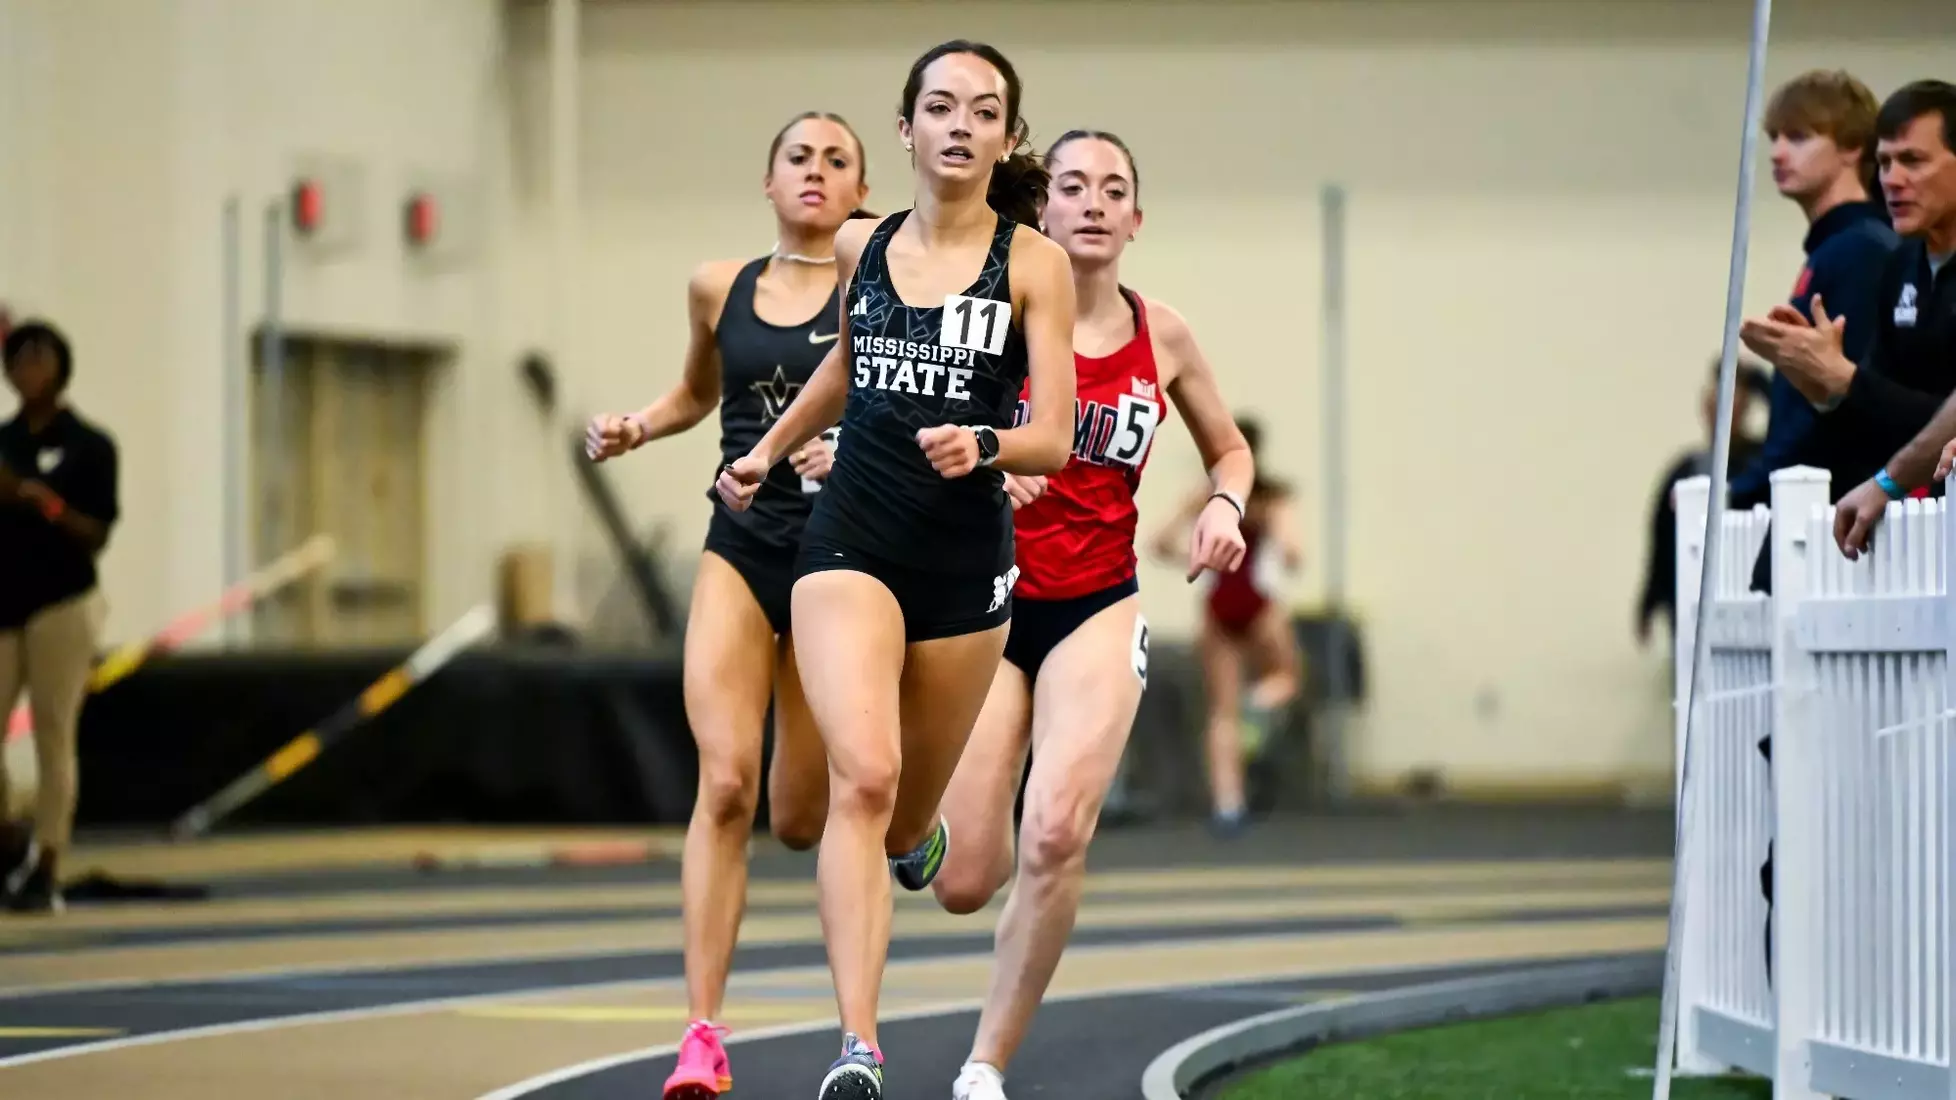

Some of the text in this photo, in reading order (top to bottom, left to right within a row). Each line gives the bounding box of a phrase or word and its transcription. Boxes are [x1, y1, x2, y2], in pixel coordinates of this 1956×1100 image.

[955, 299, 998, 350] 11
[854, 336, 976, 367] MISSISSIPPI
[854, 355, 974, 401] STATE
[1116, 401, 1150, 460] 5
